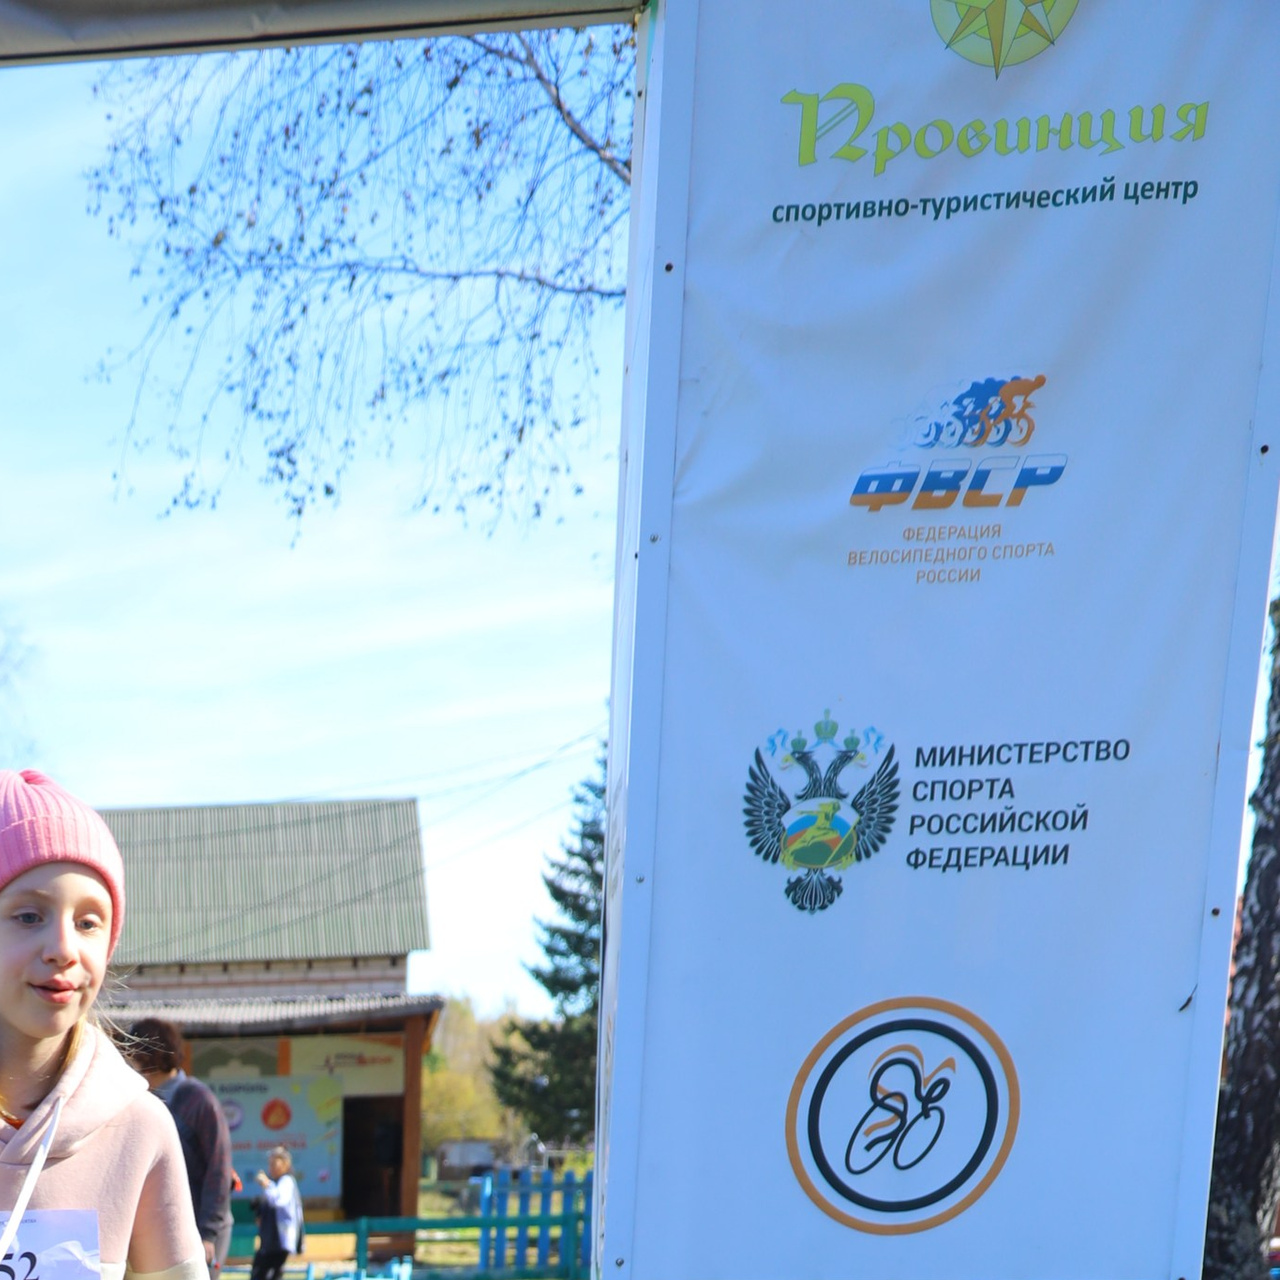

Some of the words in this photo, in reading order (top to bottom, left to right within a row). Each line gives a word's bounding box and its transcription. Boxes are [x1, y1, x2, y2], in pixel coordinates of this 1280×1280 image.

[780, 82, 1210, 177] Провинция
[771, 176, 1116, 226] спортивно-туристический
[1124, 178, 1198, 207] центр
[849, 454, 1068, 513] ФВСР
[902, 523, 1002, 544] ФЕДЕРАЦИЯ
[847, 546, 988, 567] ВЕЛОСИПЕДНОГО
[992, 542, 1056, 560] СПОРТА
[916, 568, 982, 585] РОССИИ
[915, 738, 1131, 769] МИНИСТЕРСТВО
[912, 777, 1016, 802] СПОРТА
[909, 803, 1090, 836] РОССИЙСКОЙ
[906, 843, 1070, 872] ФЕДЕРАЦИИ
